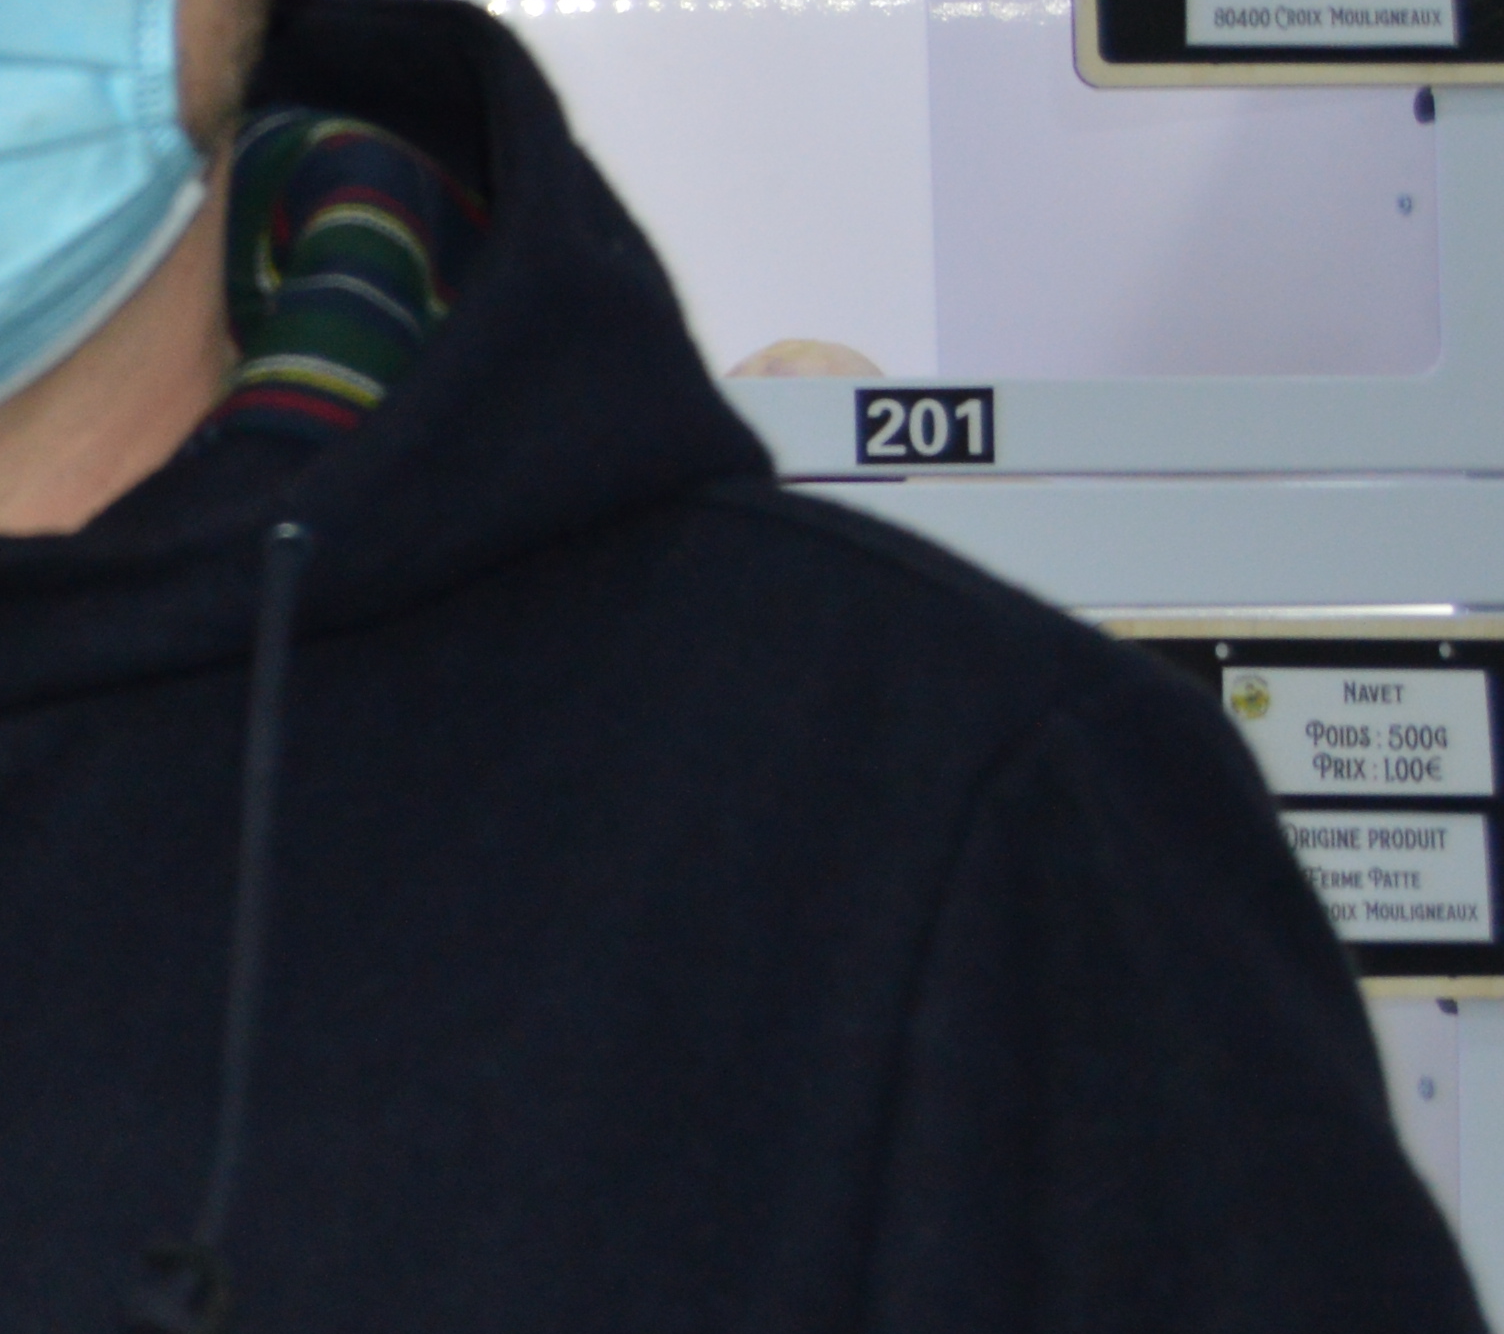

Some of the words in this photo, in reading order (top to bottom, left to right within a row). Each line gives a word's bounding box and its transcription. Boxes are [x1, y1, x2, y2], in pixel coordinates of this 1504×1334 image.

[1214, 7, 1270, 27] 80400
[1275, 5, 1322, 29] CROIX
[1330, 5, 1441, 27] MOULIGNEAUX
[865, 398, 985, 456] 201
[1343, 681, 1404, 704] NAVET
[1305, 720, 1371, 747] POIDS
[1388, 724, 1448, 750] 500G
[1312, 753, 1366, 781] PRIX
[1368, 827, 1447, 850] PRODUIT
[1368, 866, 1421, 890] PATTE
[1363, 899, 1478, 921] MOULIGNEAUX
